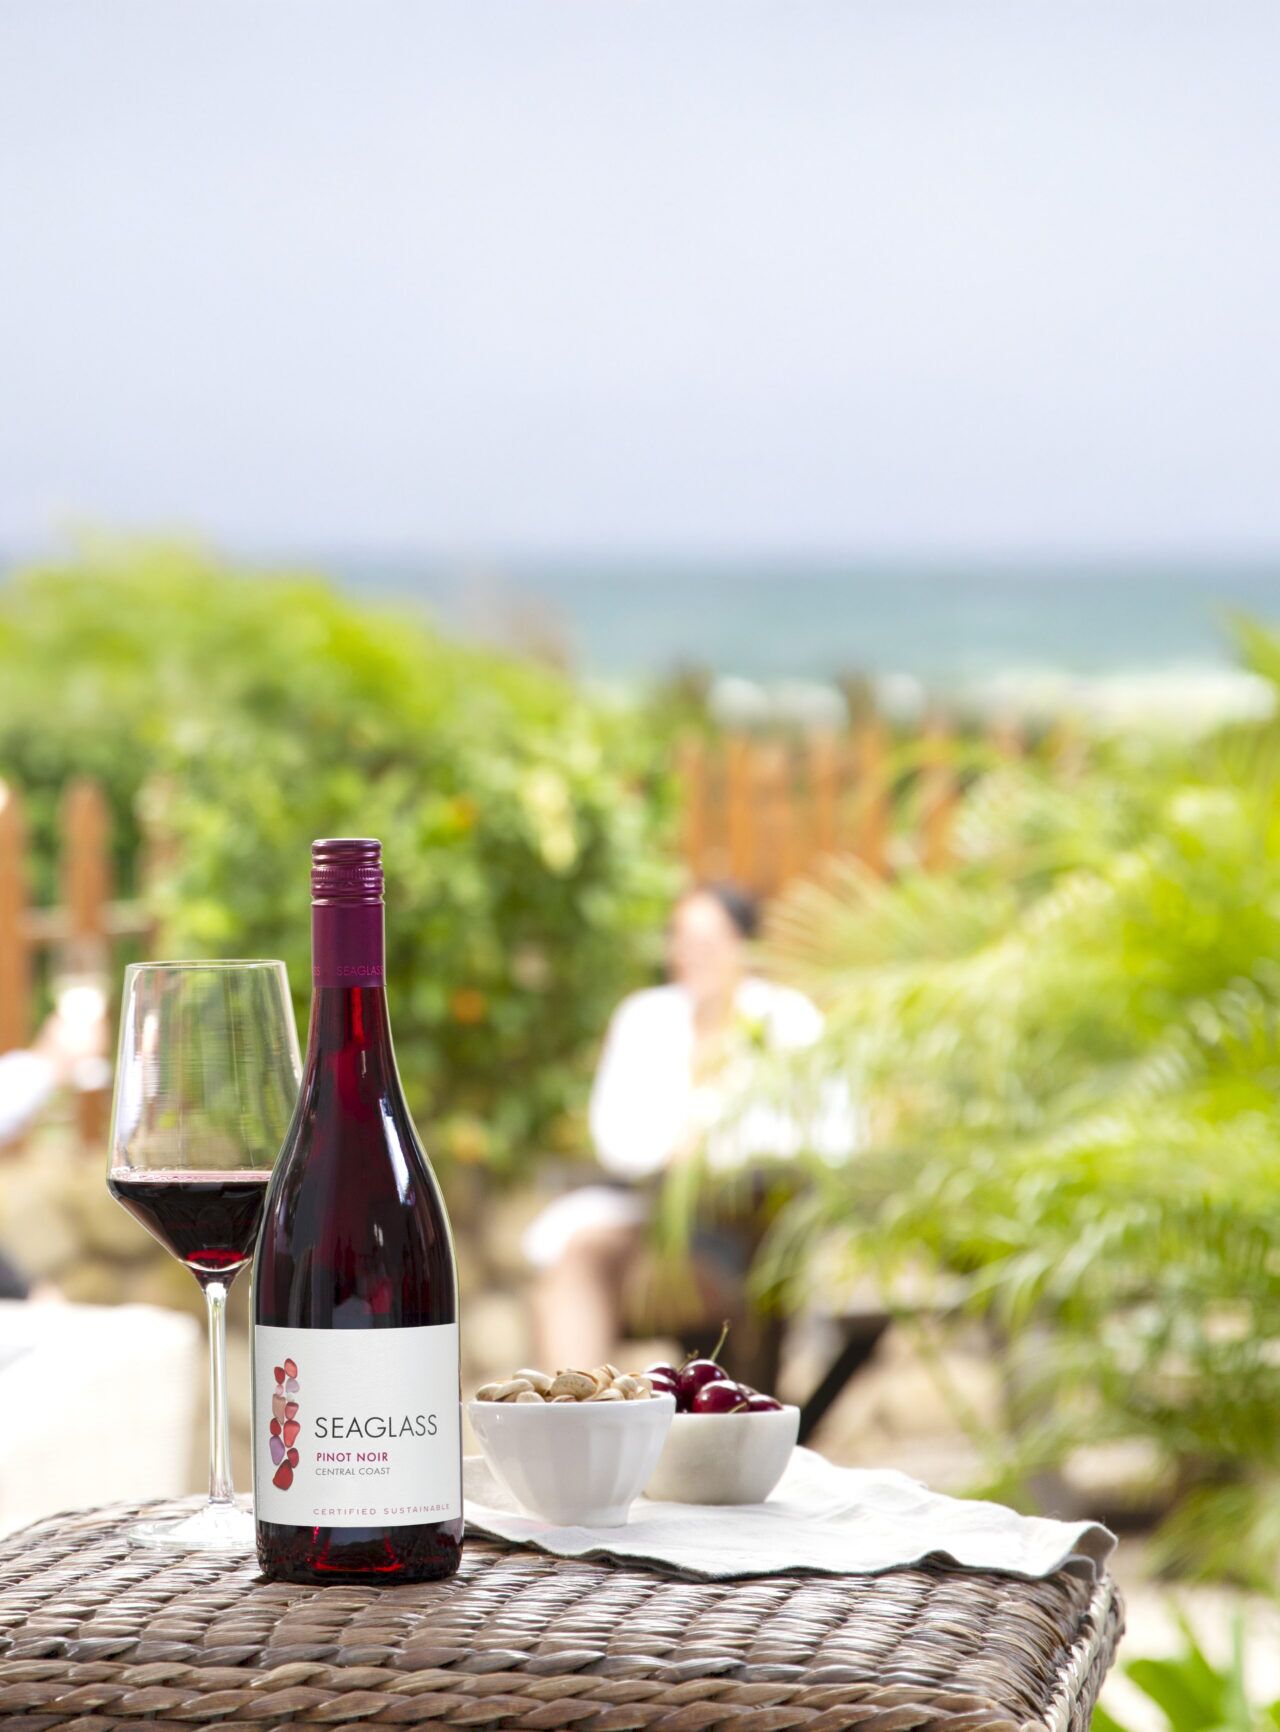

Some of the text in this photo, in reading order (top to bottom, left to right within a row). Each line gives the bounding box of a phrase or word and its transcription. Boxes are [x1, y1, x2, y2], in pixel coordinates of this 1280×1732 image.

[314, 1414, 438, 1439] SEAGLASS
[316, 1452, 389, 1462] PINOT NOIR
[315, 1467, 391, 1476] CENTRAL COAST
[313, 1503, 450, 1516] CERTIFIED SUSTAINABLE
